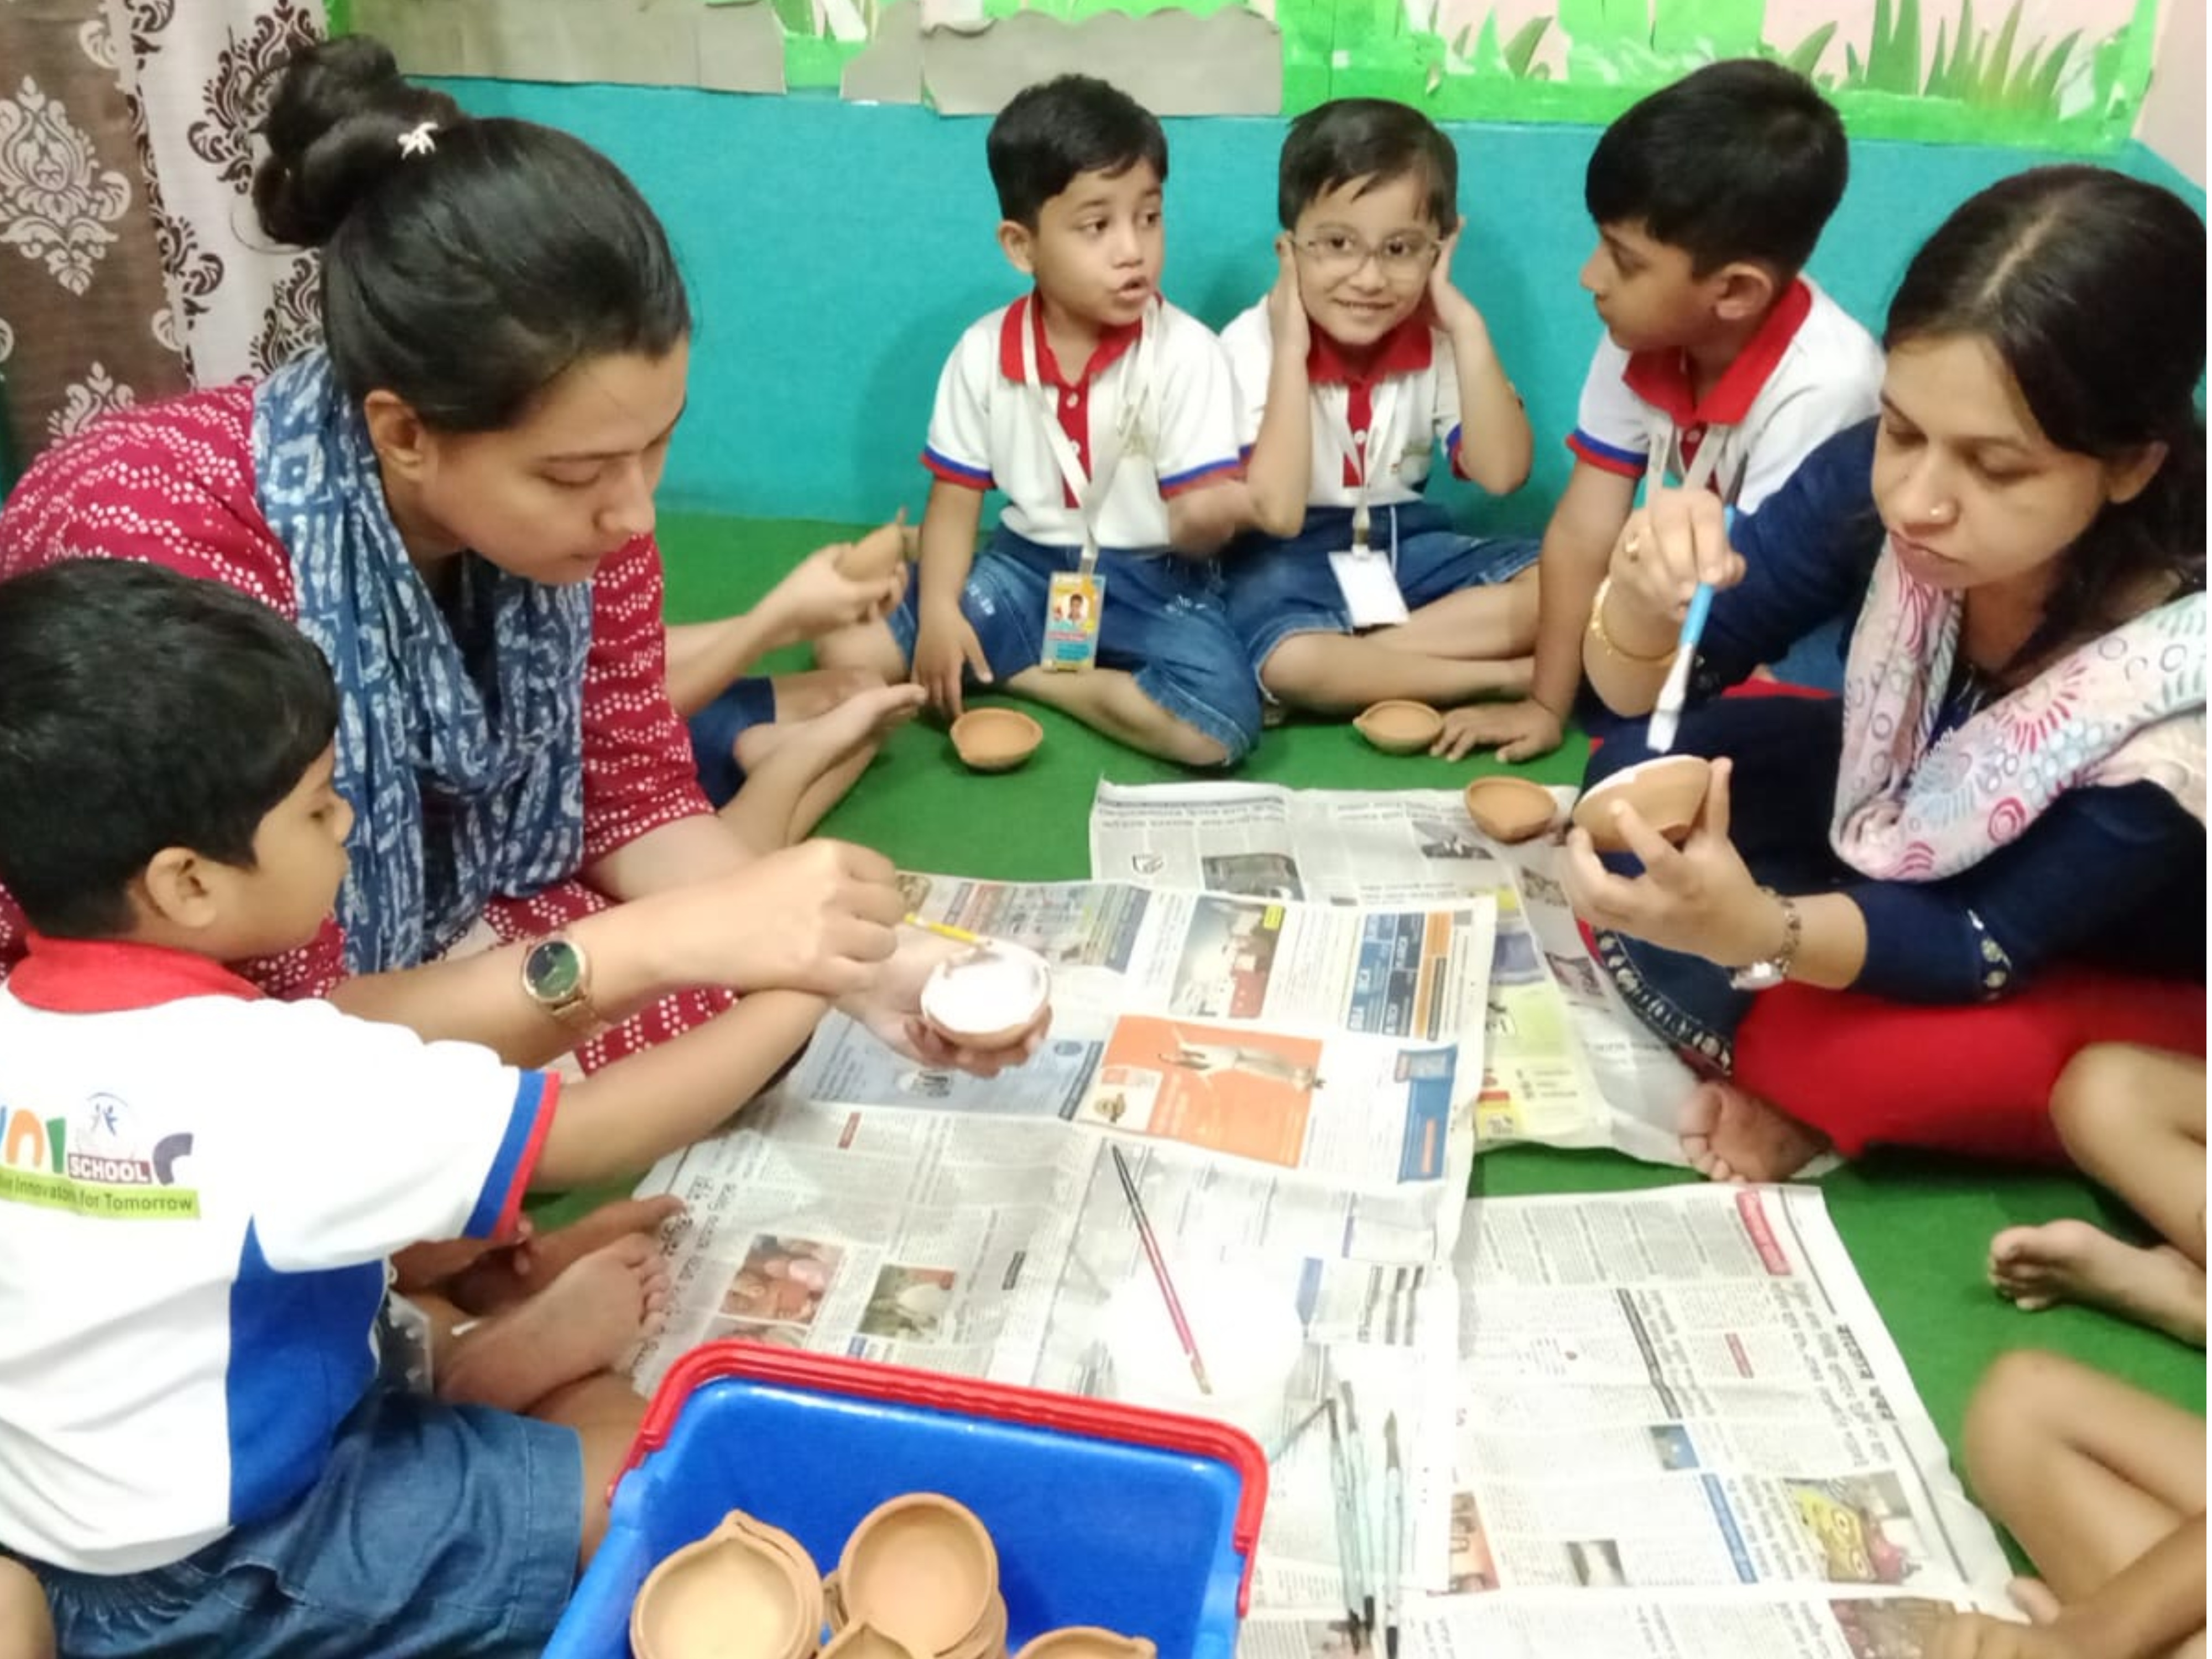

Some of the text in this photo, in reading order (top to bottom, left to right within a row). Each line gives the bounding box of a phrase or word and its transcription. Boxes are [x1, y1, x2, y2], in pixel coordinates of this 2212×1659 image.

[70, 1156, 149, 1182] SCHOOL
[81, 1191, 100, 1208] for
[105, 1193, 192, 1211] Tomorrow
